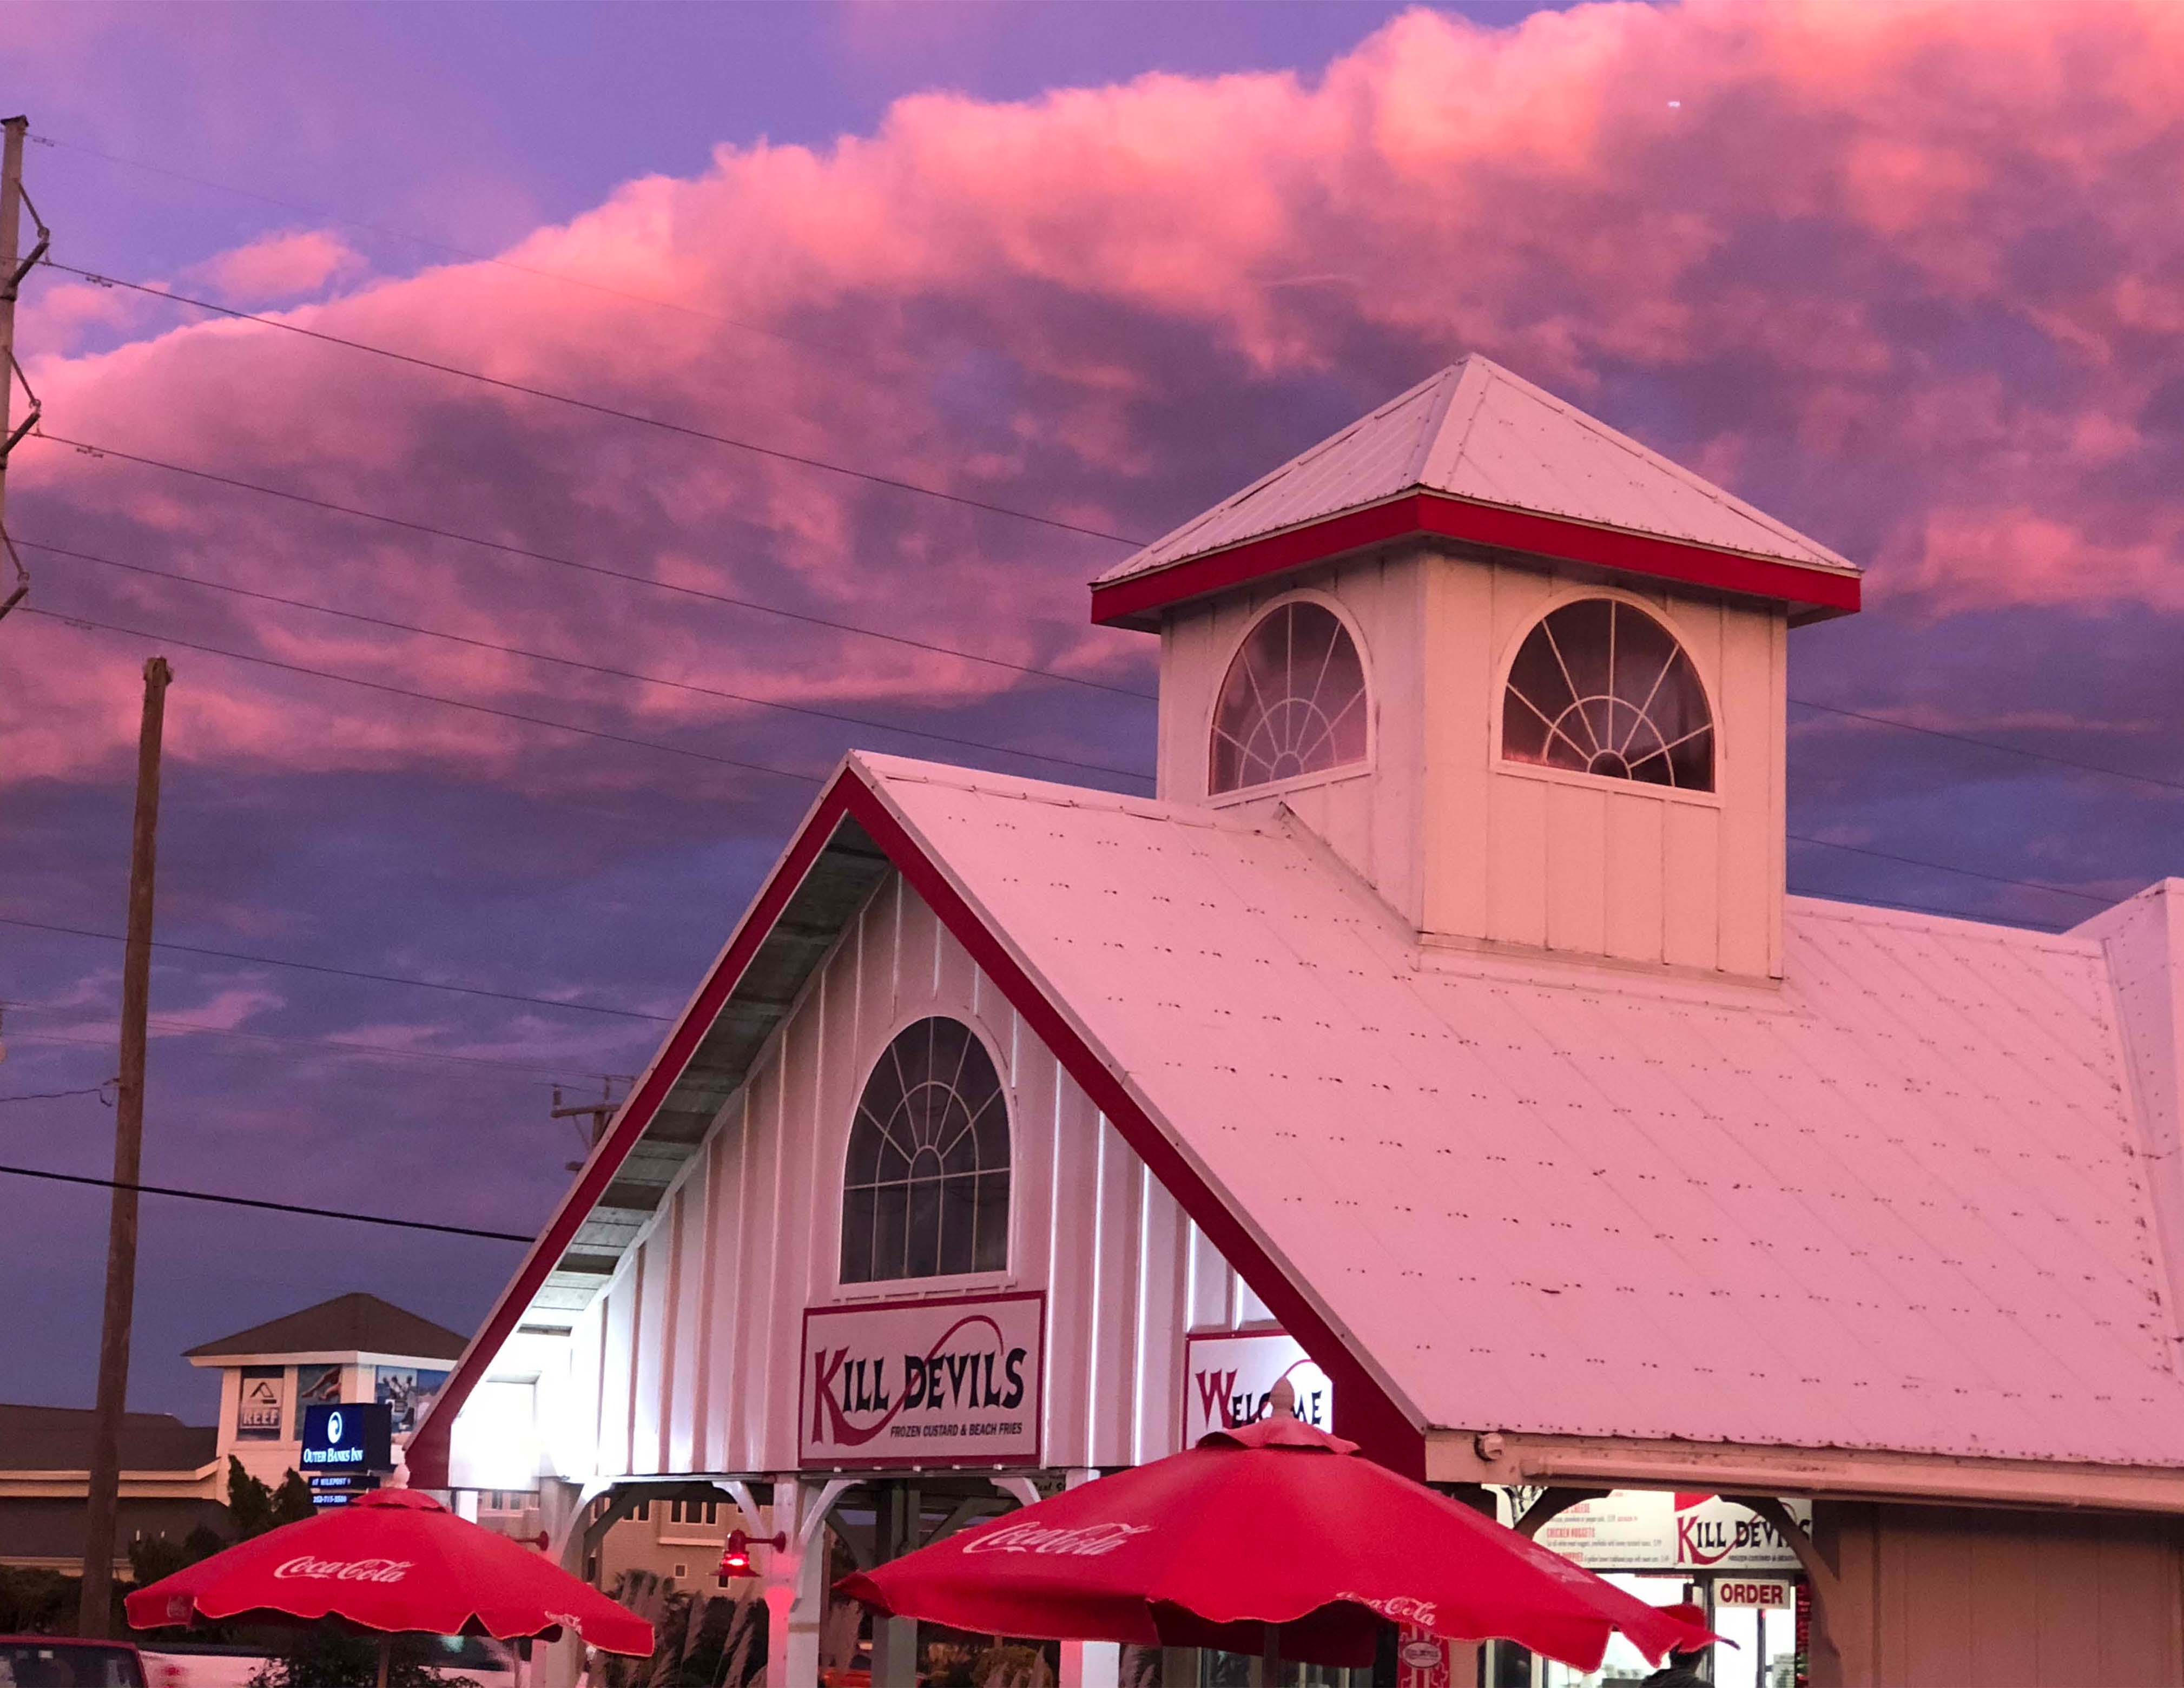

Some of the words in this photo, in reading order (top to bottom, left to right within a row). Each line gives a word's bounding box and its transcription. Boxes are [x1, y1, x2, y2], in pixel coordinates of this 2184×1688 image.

[811, 1346, 890, 1446] KILL
[903, 1347, 1027, 1410] DEVILS
[1195, 1369, 1322, 1429] WELCME
[890, 1426, 921, 1438] FROZEN
[923, 1425, 959, 1437] CUSTARD
[960, 1425, 967, 1435] &
[969, 1423, 997, 1436] BEACH
[999, 1422, 1022, 1435] FRIES
[303, 1448, 327, 1463] OUTER
[327, 1448, 351, 1462] BANKS
[351, 1447, 364, 1462] INN
[1677, 1514, 1726, 1565] KILL
[274, 1555, 418, 1582] Coca-Cola
[1721, 1583, 1783, 1604] ORDER
